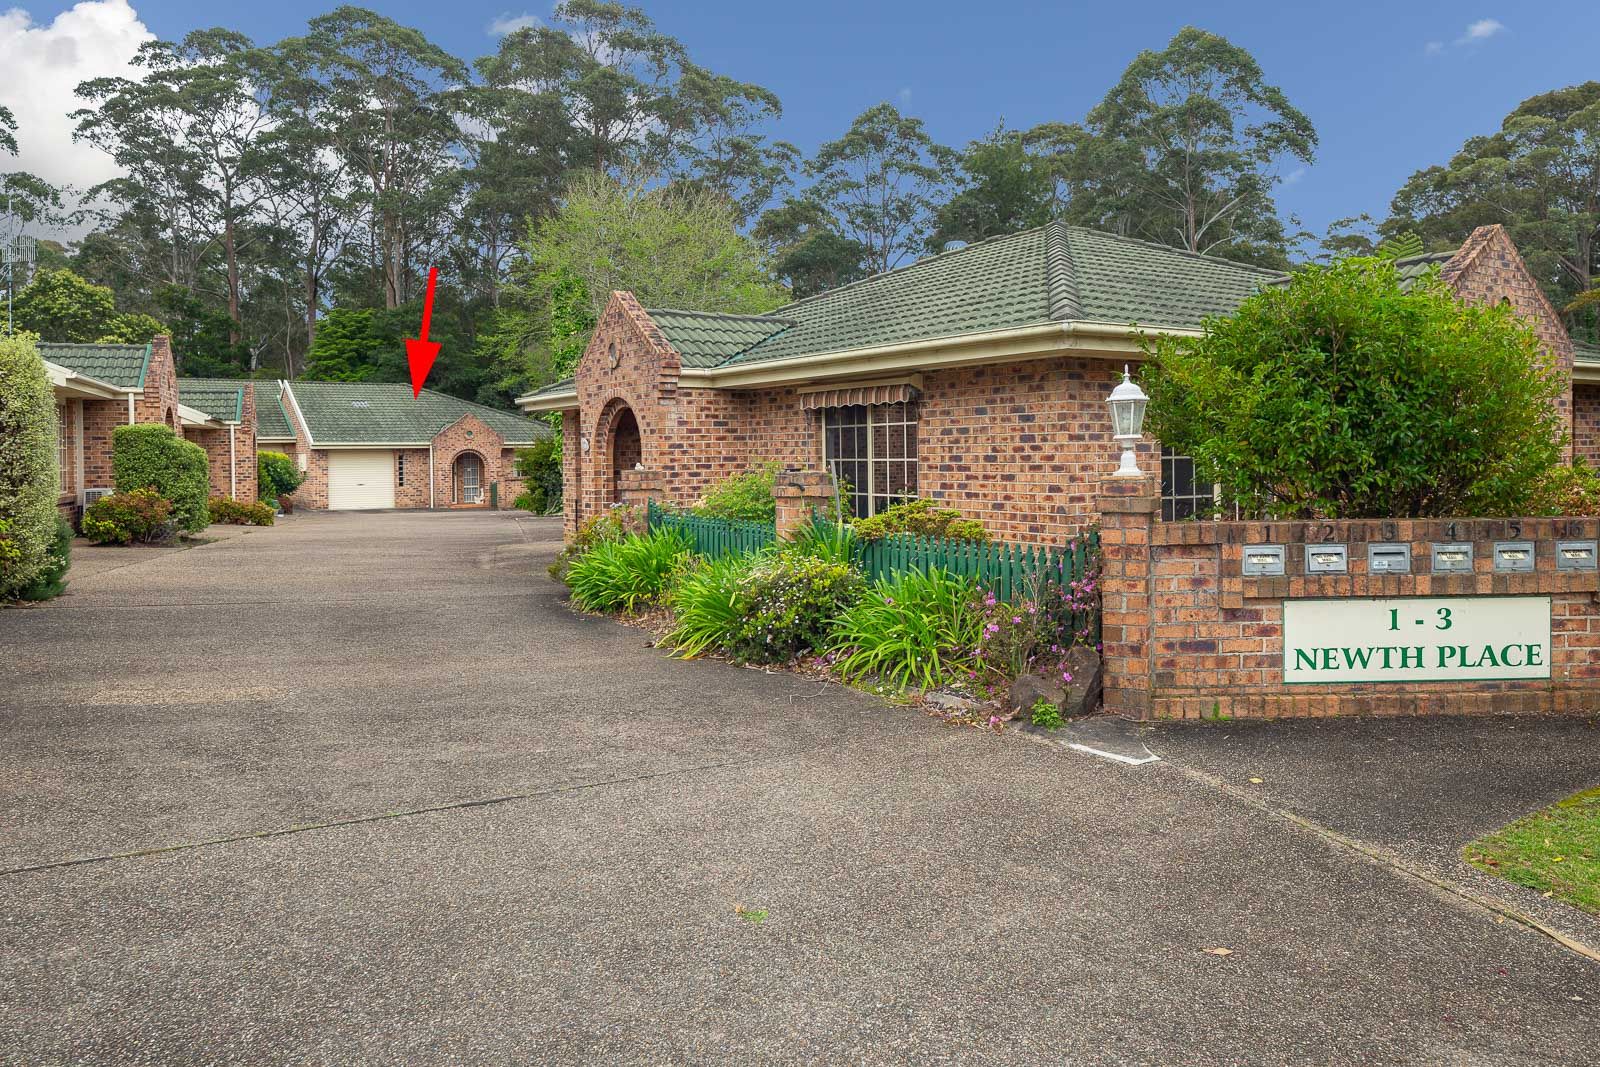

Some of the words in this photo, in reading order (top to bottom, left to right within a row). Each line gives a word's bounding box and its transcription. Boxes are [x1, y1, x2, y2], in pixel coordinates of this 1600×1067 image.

[1263, 525, 1272, 542] 1
[1322, 525, 1335, 541] 2
[1384, 523, 1396, 540] 3
[1445, 522, 1457, 540] 4
[1509, 522, 1521, 539] 5
[1388, 608, 1401, 631] 1
[1435, 607, 1453, 631] 3
[1293, 646, 1426, 671] NEWTH
[1436, 643, 1543, 669] PLACE
